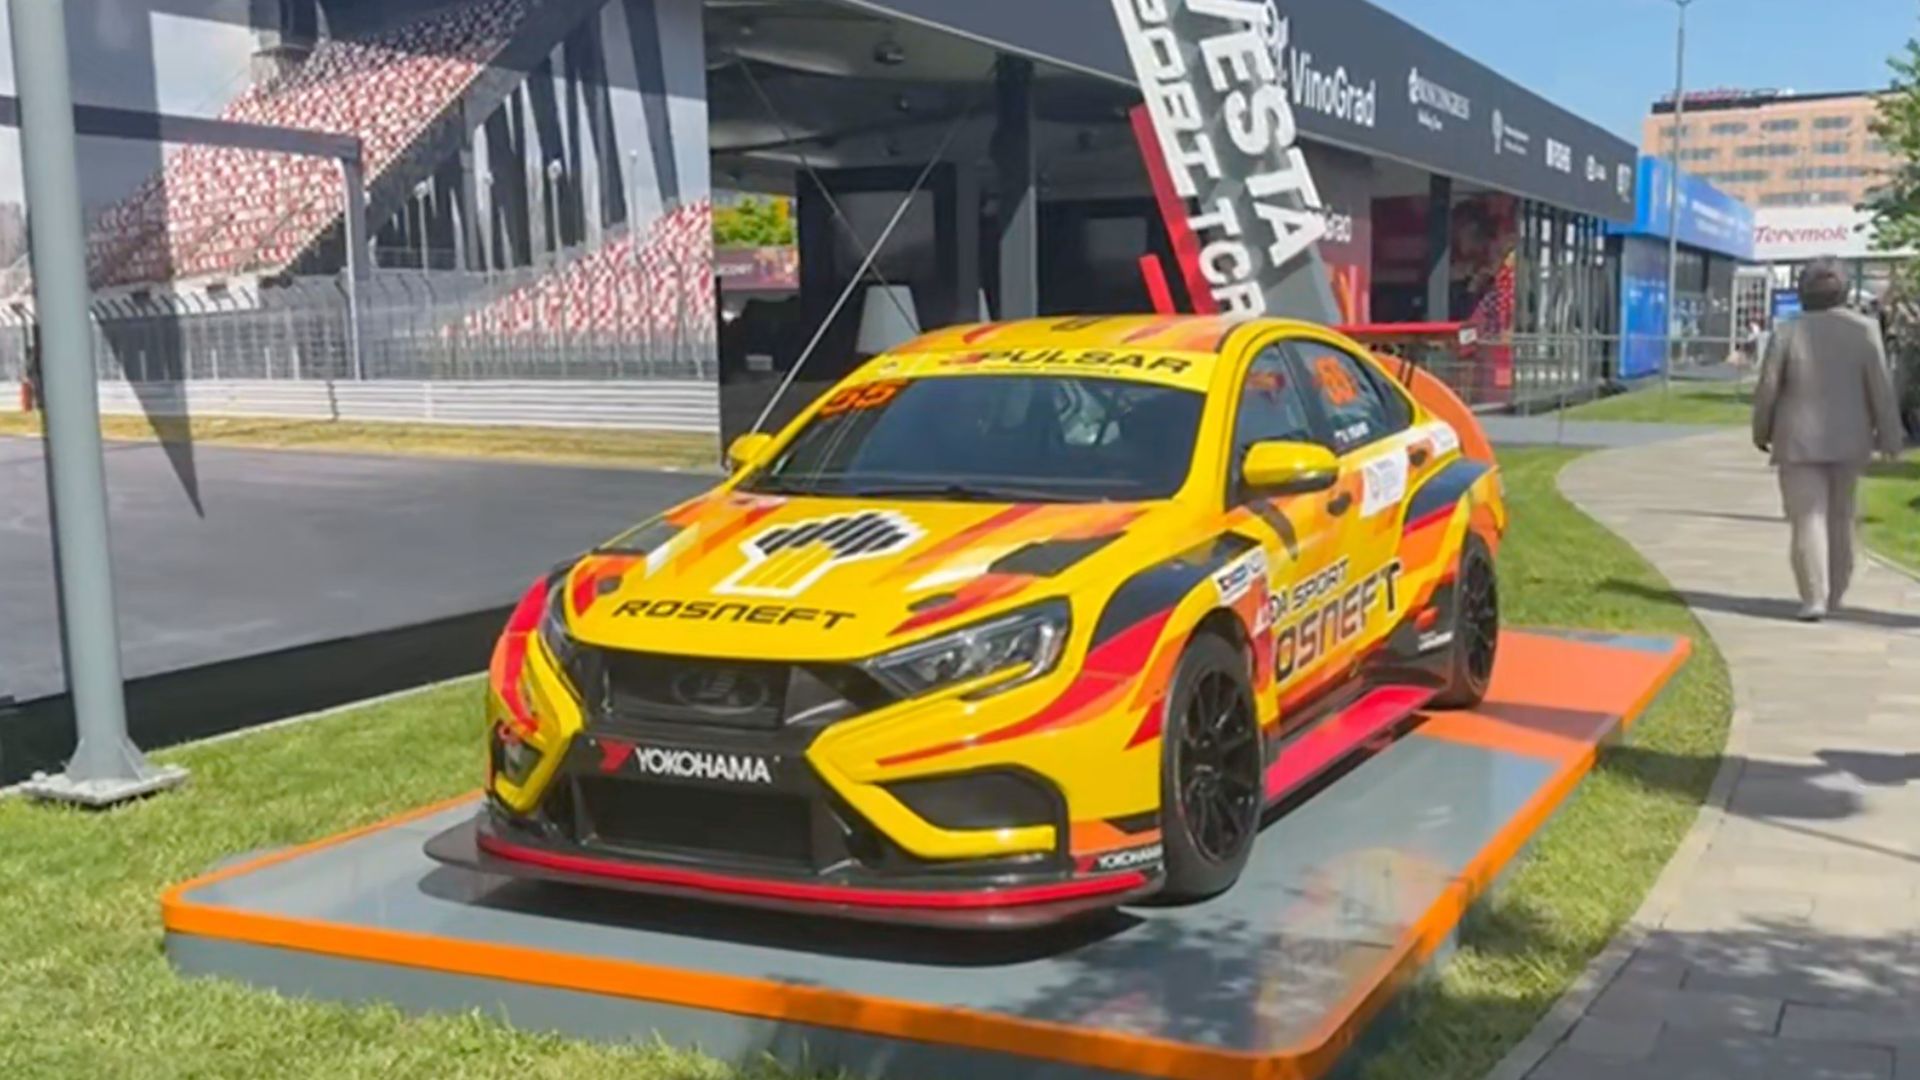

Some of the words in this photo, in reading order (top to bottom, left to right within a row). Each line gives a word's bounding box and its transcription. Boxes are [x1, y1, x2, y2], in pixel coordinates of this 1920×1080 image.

[1290, 46, 1376, 128] VinoGrad
[1753, 225, 1849, 244] Teremok
[1186, 197, 1267, 318] TCR
[977, 350, 1193, 374] PULSAR
[1292, 557, 1349, 610] SPORT
[612, 599, 857, 630] ROSNEFT
[634, 745, 772, 785] YOKOHAMA
